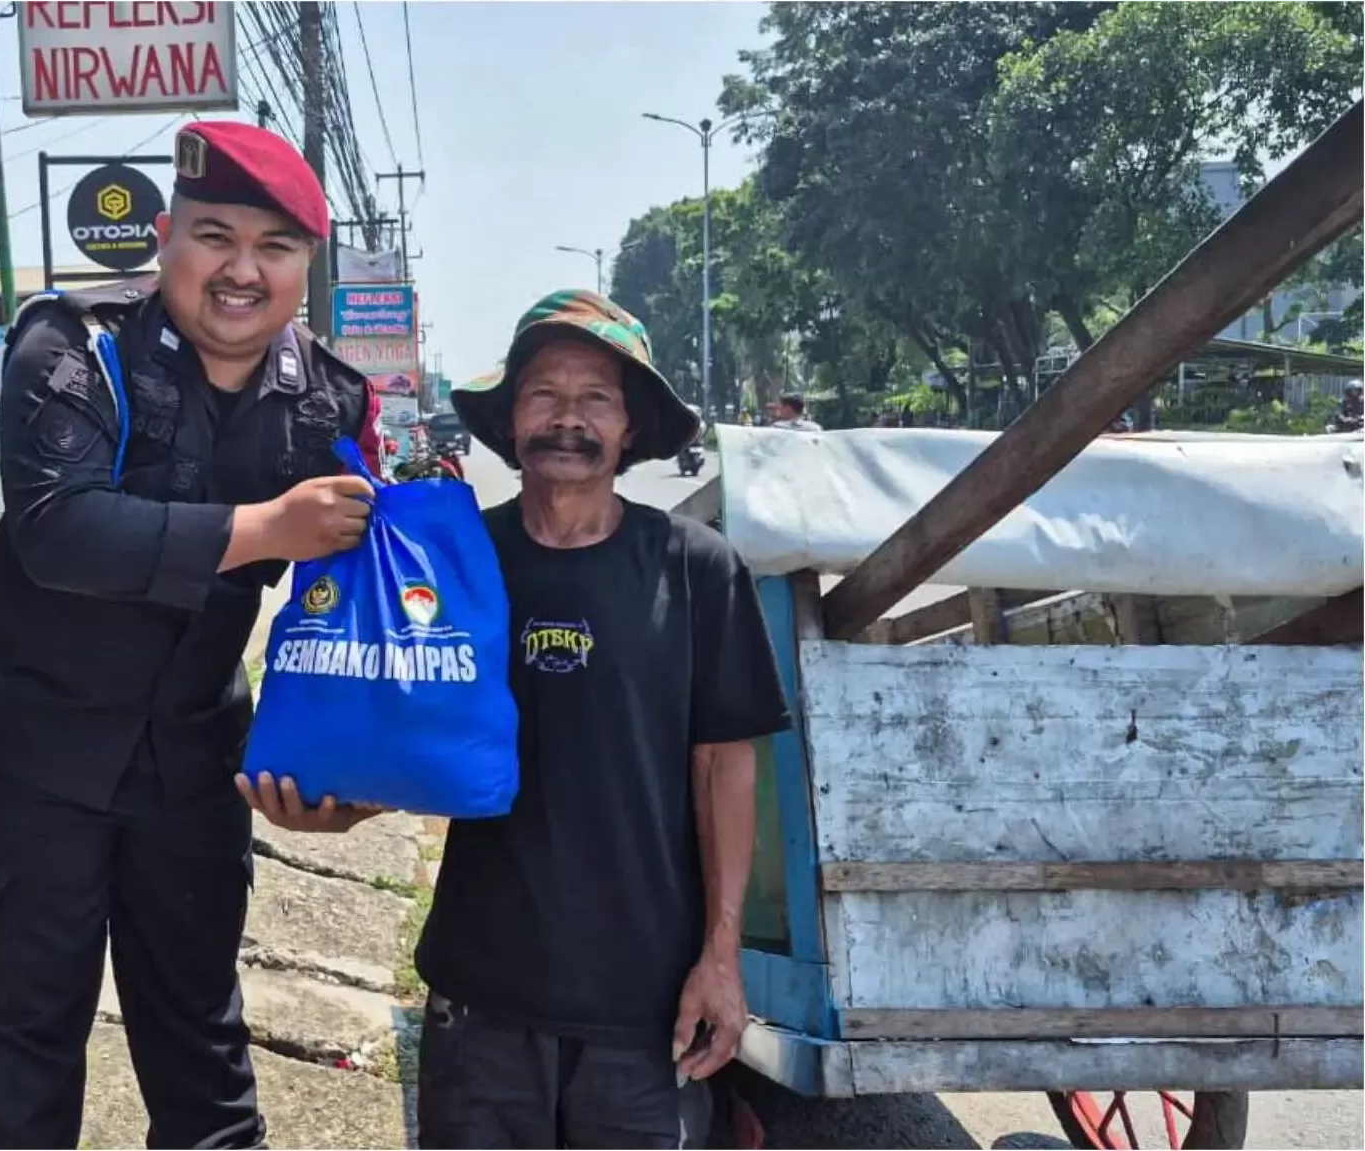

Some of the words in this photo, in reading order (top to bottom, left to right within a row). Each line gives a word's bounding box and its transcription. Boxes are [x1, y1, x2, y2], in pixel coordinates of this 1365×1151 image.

[32, 41, 228, 102] NIRWANA
[72, 223, 159, 240] OTOPIA
[273, 638, 379, 680] SEMBAKO
[384, 642, 477, 683] IMIPAS
